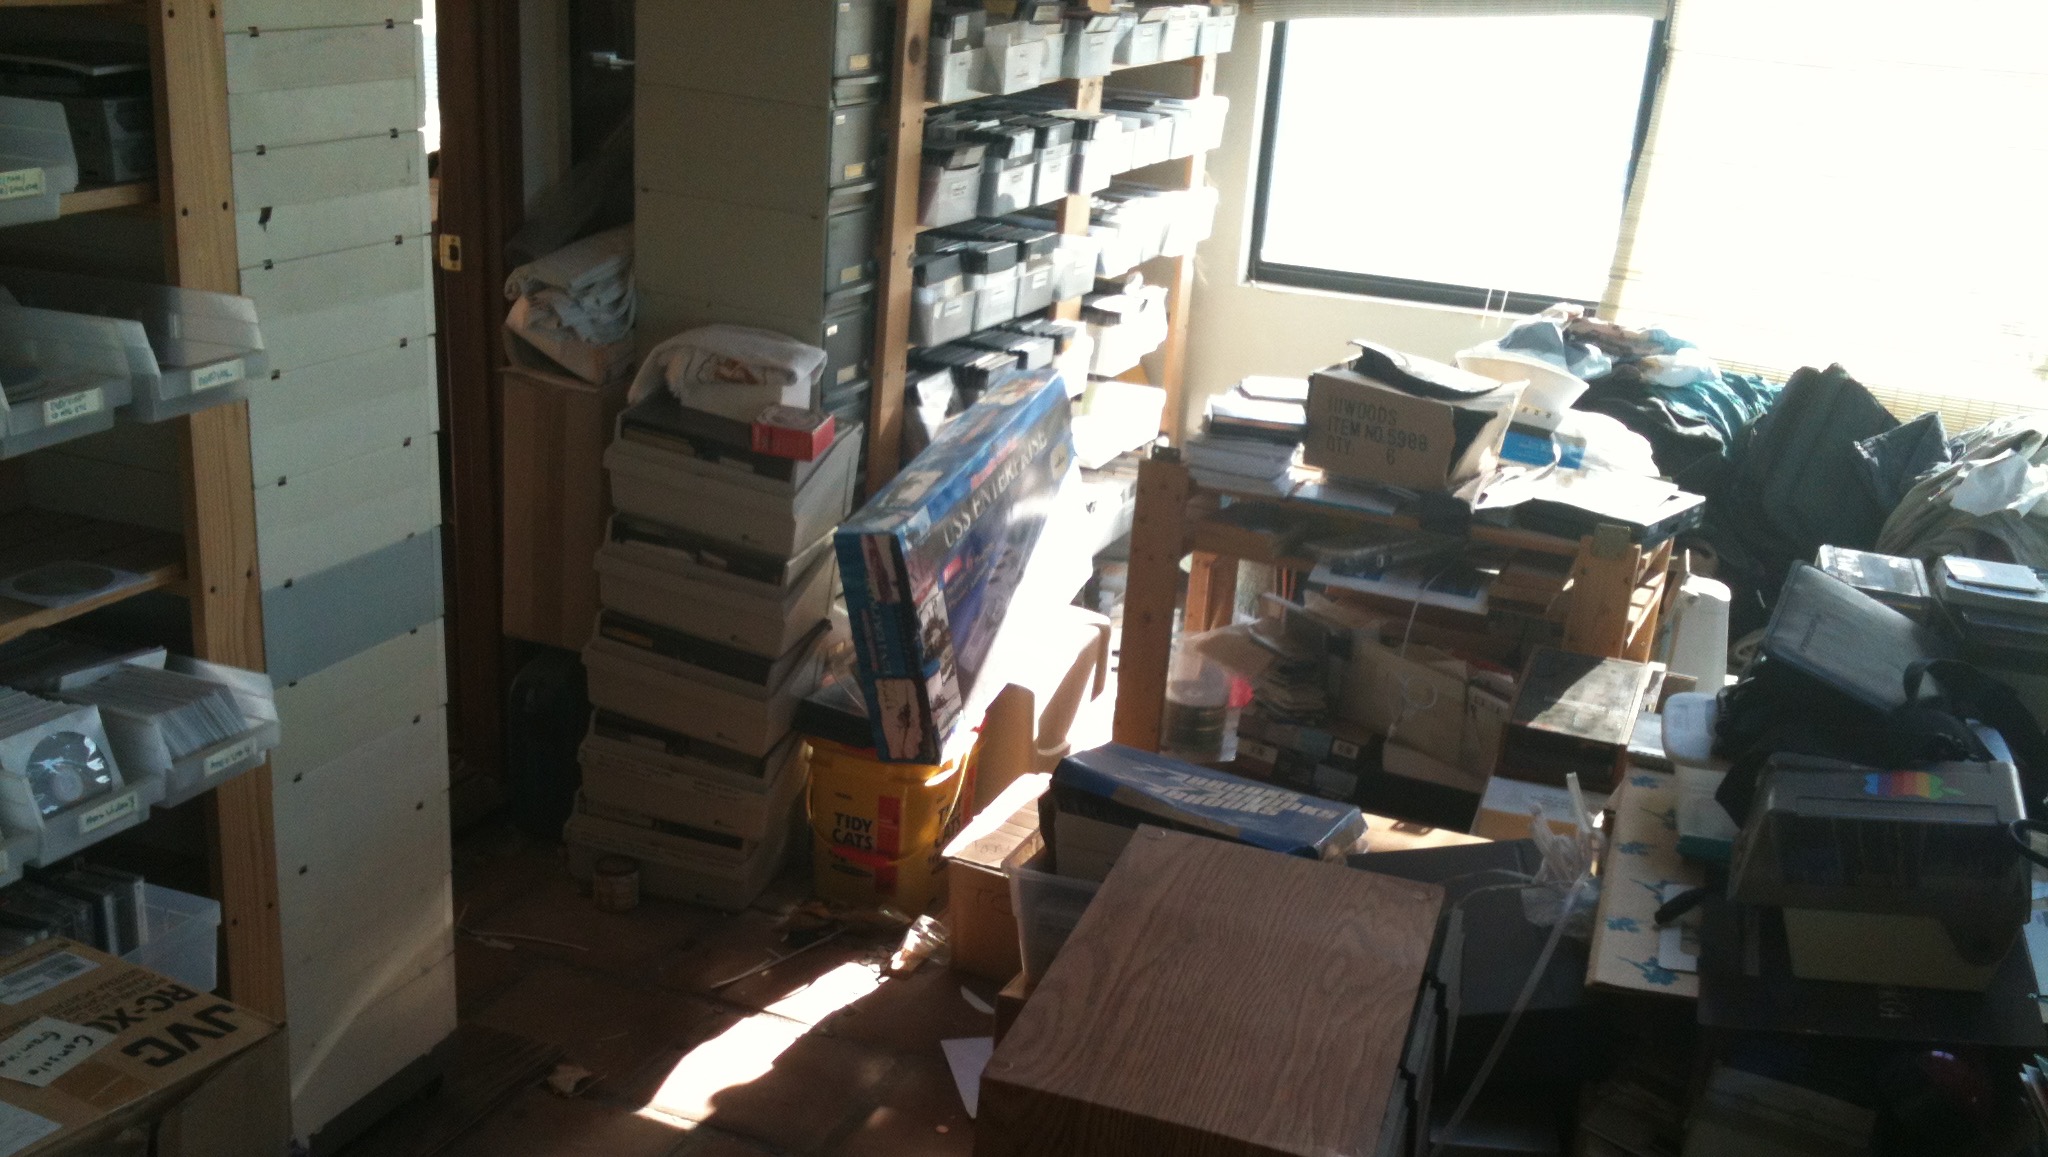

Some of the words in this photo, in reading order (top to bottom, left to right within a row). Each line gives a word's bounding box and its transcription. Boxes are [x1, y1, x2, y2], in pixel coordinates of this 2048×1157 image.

[1327, 415, 1360, 437] ITEM
[834, 812, 873, 832] TIDY
[832, 828, 873, 850] CATS
[119, 1002, 238, 1068] JVC
[27, 1034, 94, 1076] Console
